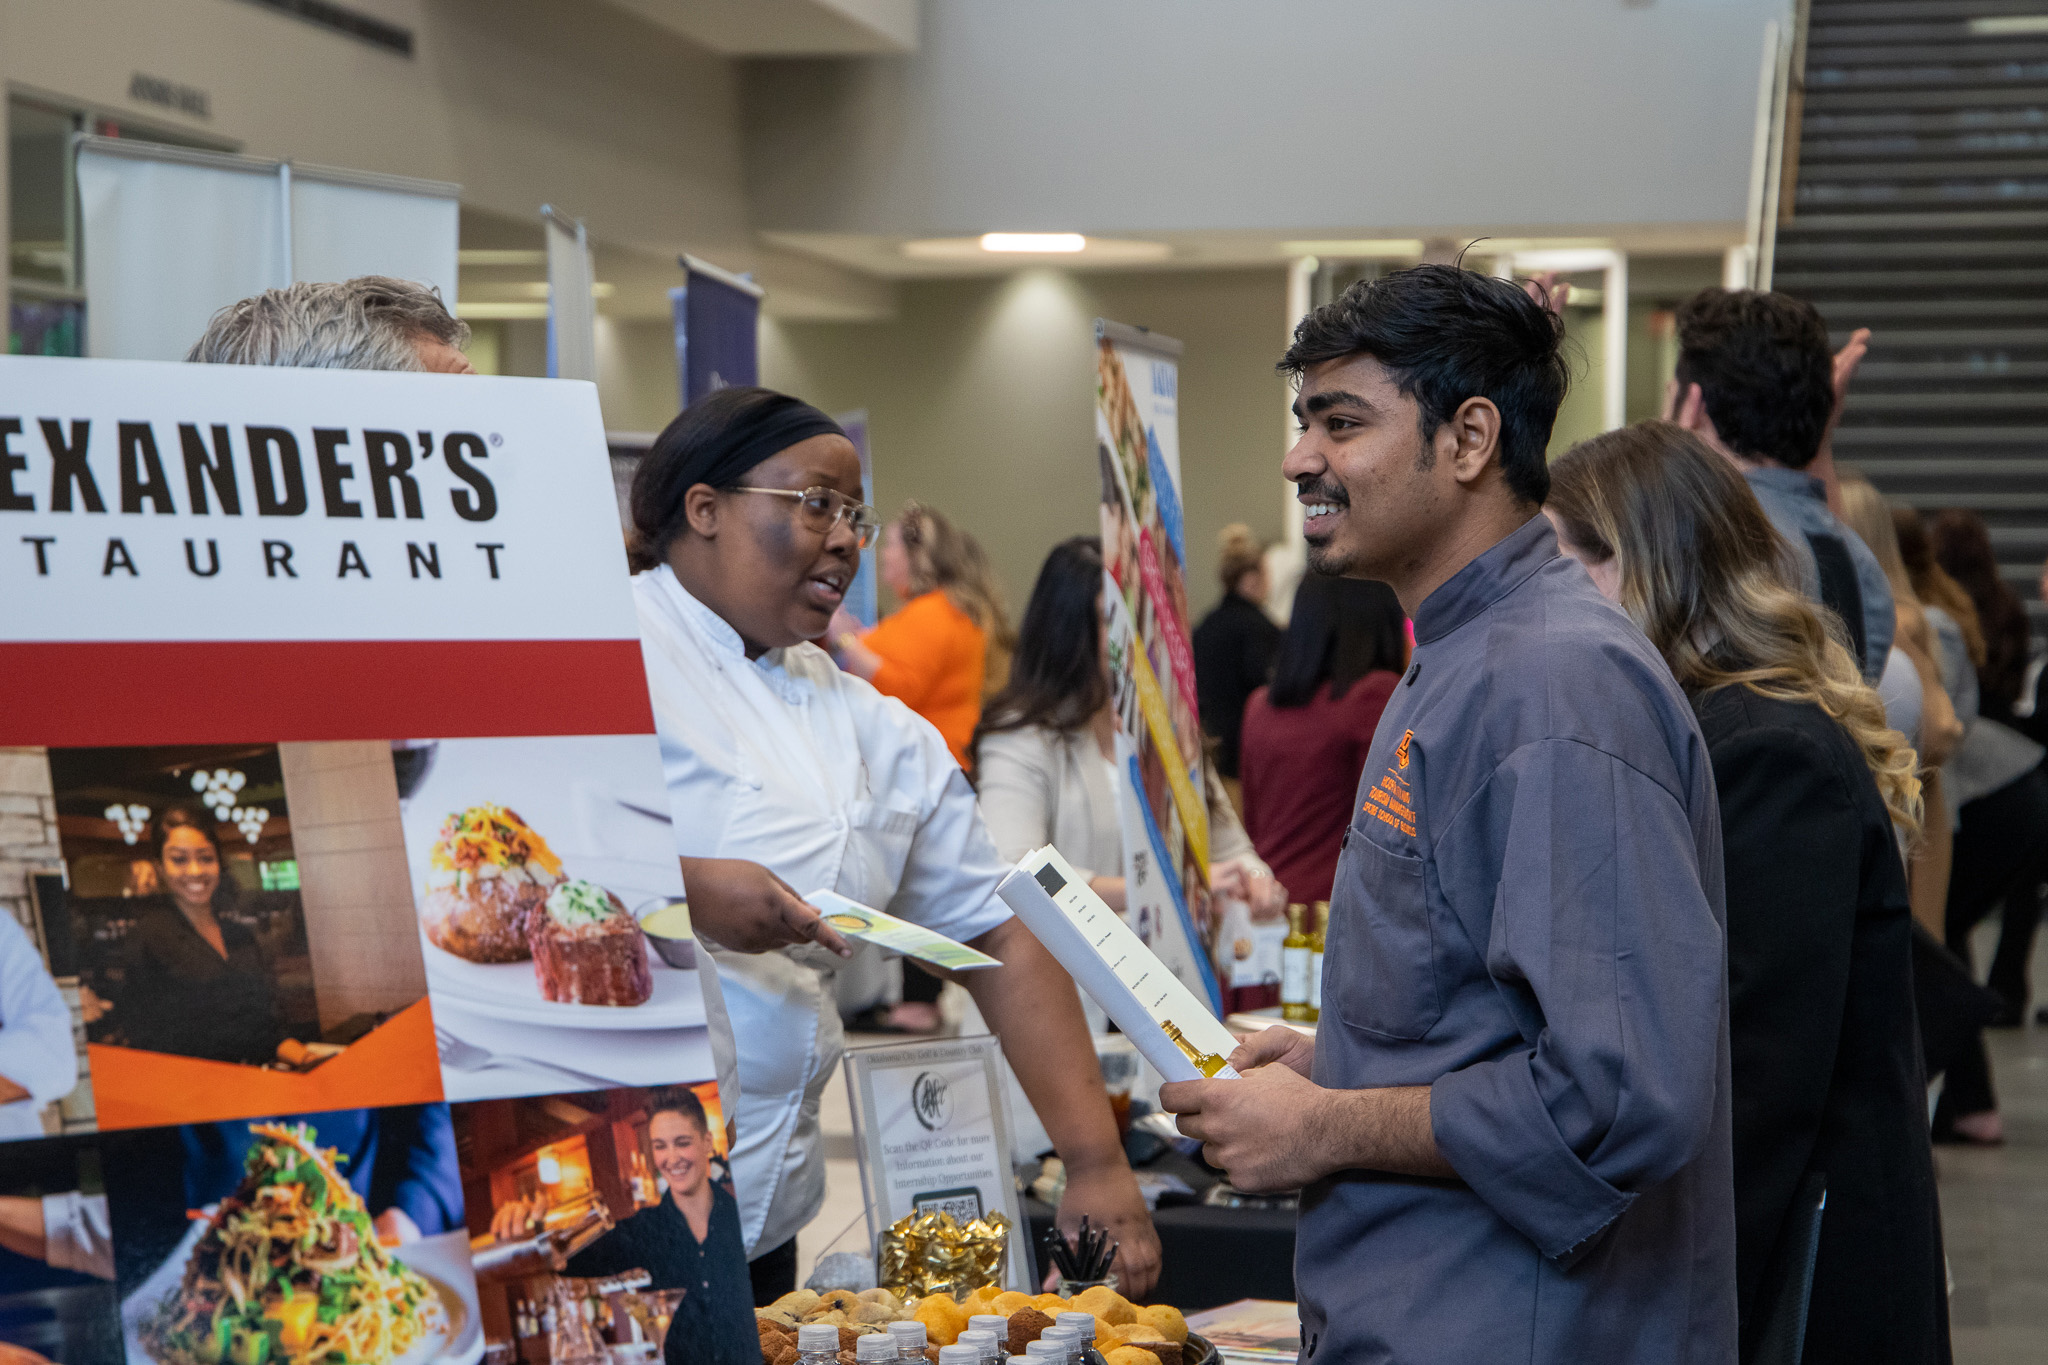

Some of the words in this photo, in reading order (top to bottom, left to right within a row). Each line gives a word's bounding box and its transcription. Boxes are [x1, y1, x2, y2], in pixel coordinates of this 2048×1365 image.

[21, 535, 505, 580] TAURANT
[883, 1142, 904, 1155] Scan
[904, 1140, 919, 1152] the
[935, 1138, 954, 1150] Code
[957, 1136, 968, 1146] for
[971, 1134, 992, 1144] more
[896, 1156, 944, 1171] Information
[946, 1154, 968, 1165] about
[971, 1152, 984, 1161] our
[895, 1173, 937, 1189] Internship
[938, 1168, 994, 1184] Opportunities
